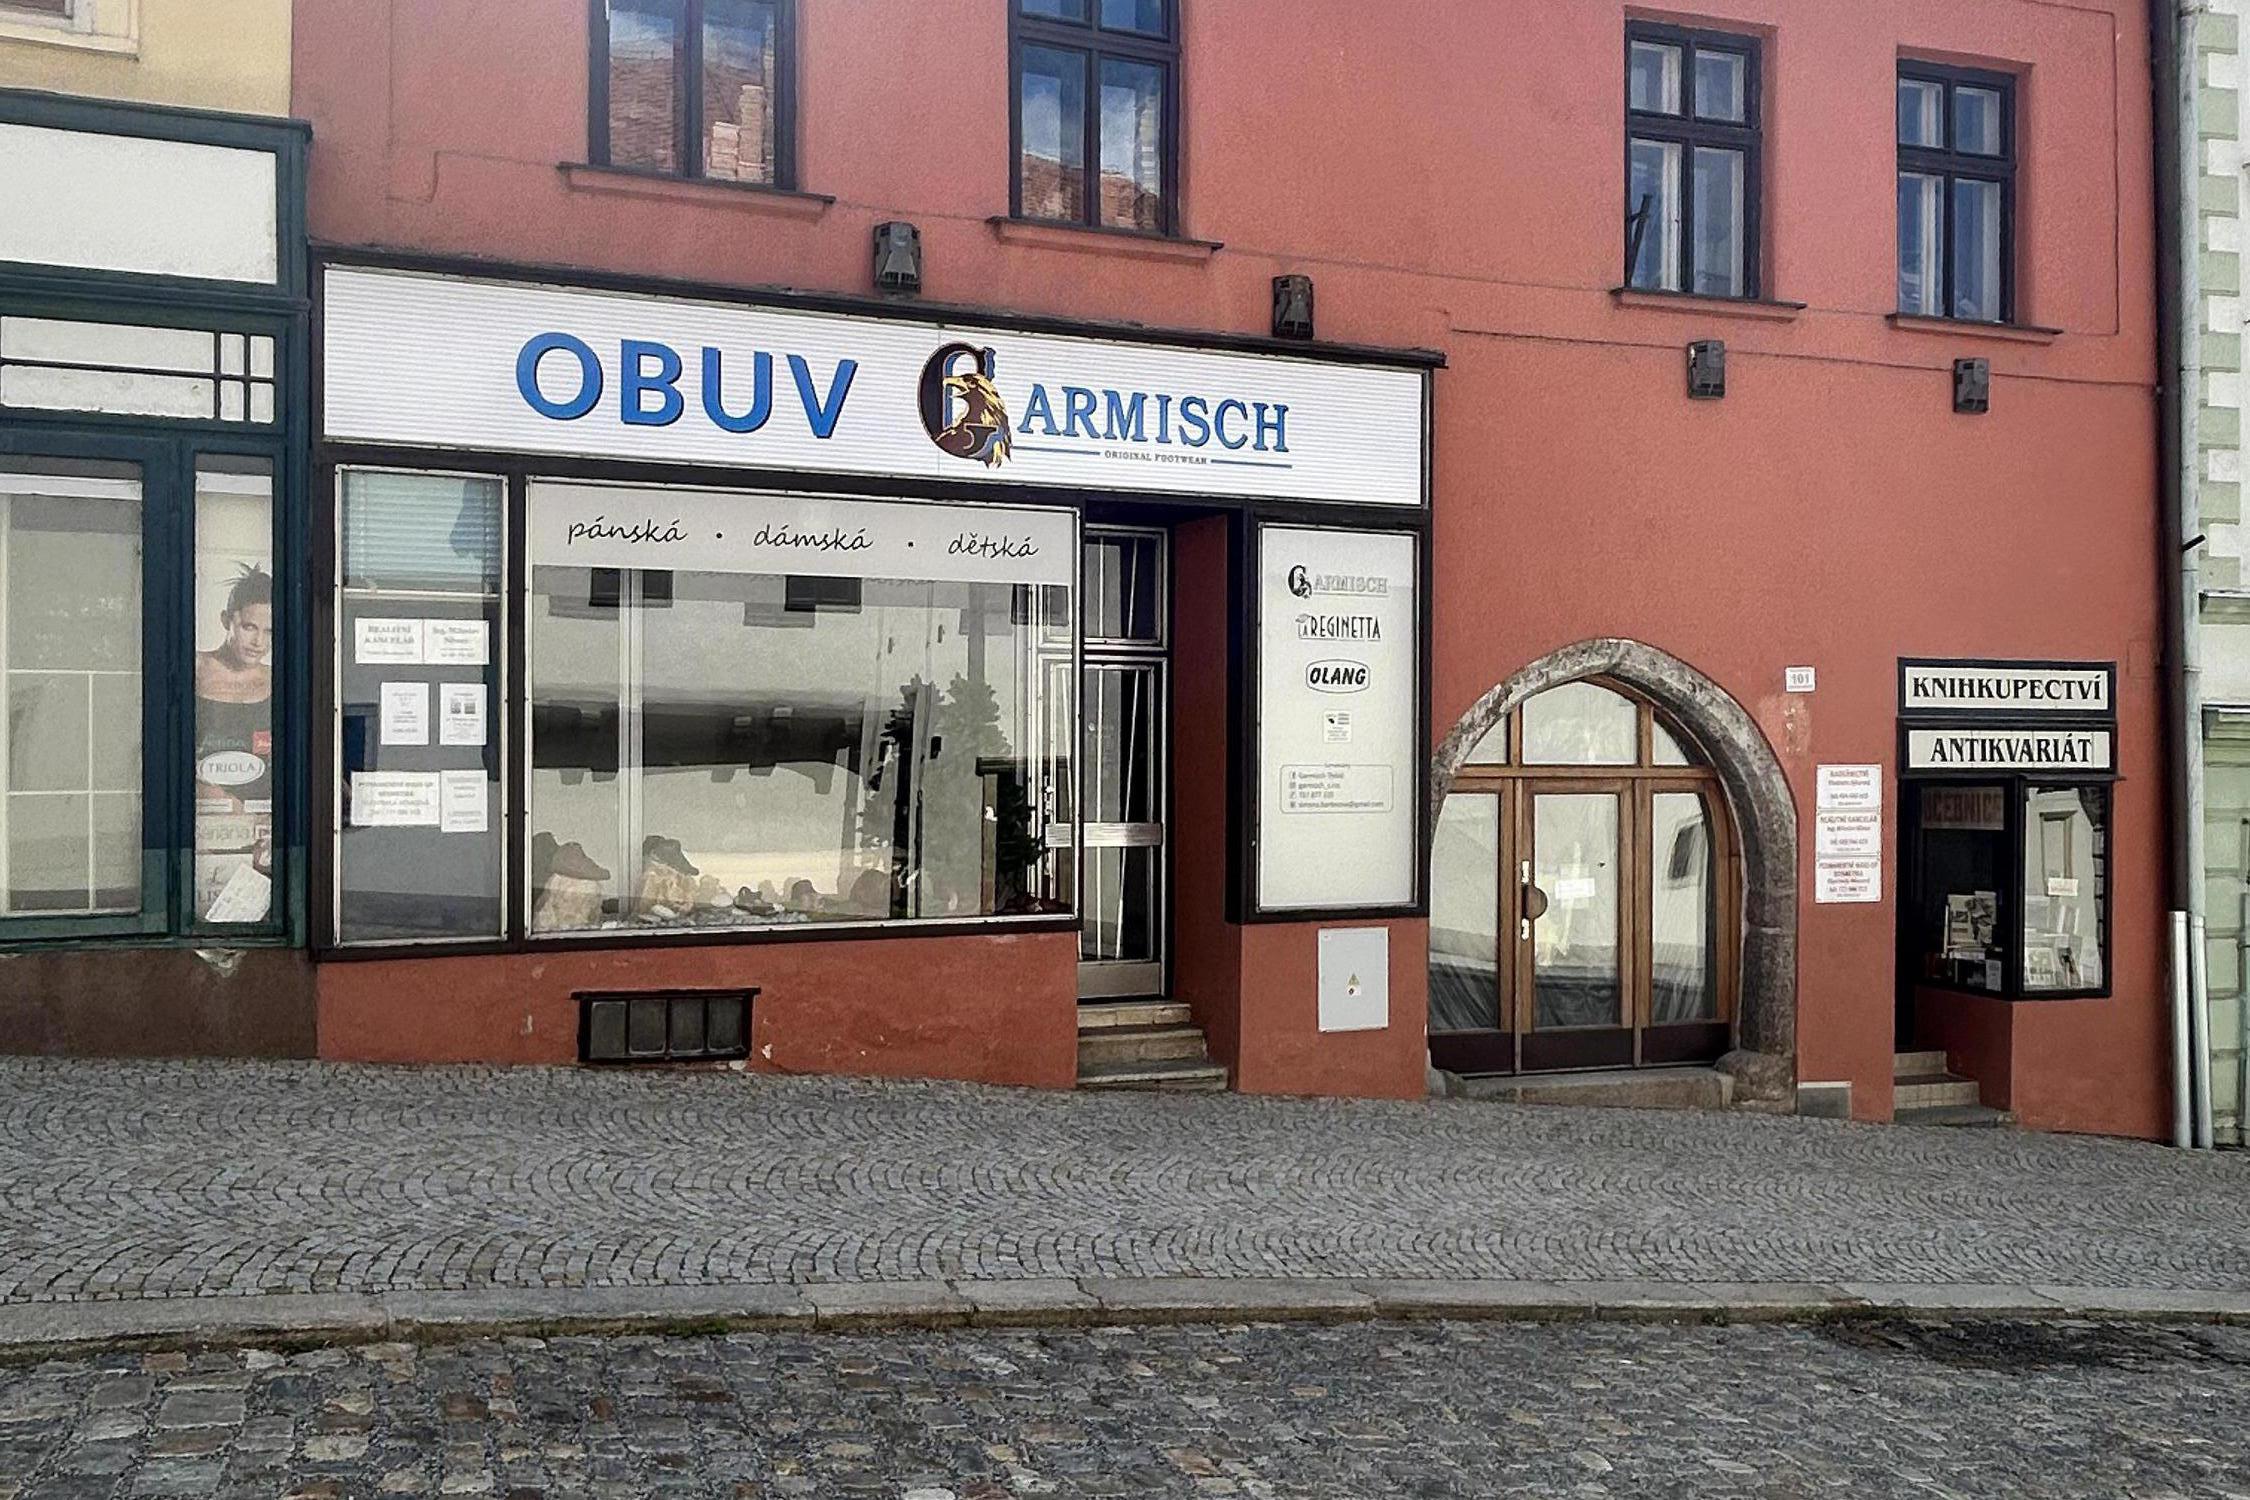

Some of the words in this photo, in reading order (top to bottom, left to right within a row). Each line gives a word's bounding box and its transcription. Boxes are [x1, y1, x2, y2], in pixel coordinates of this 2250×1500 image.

[514, 332, 857, 439] OBUV
[1104, 450, 1152, 461] ORIGINAL
[1154, 453, 1207, 465] FOOTWEAR
[567, 515, 688, 545] pánská
[753, 523, 874, 552] dámská
[948, 532, 1040, 559] dětská
[1288, 564, 1388, 599] GARMISCH
[1310, 615, 1381, 639] REGINETTA
[1309, 666, 1366, 686] OLANG
[1791, 673, 1810, 685] 101
[1912, 674, 2102, 701] KNIHKUPECTVÍ
[1929, 733, 2093, 763] ANTIKVARIÁT
[207, 761, 257, 774] TRIOLA
